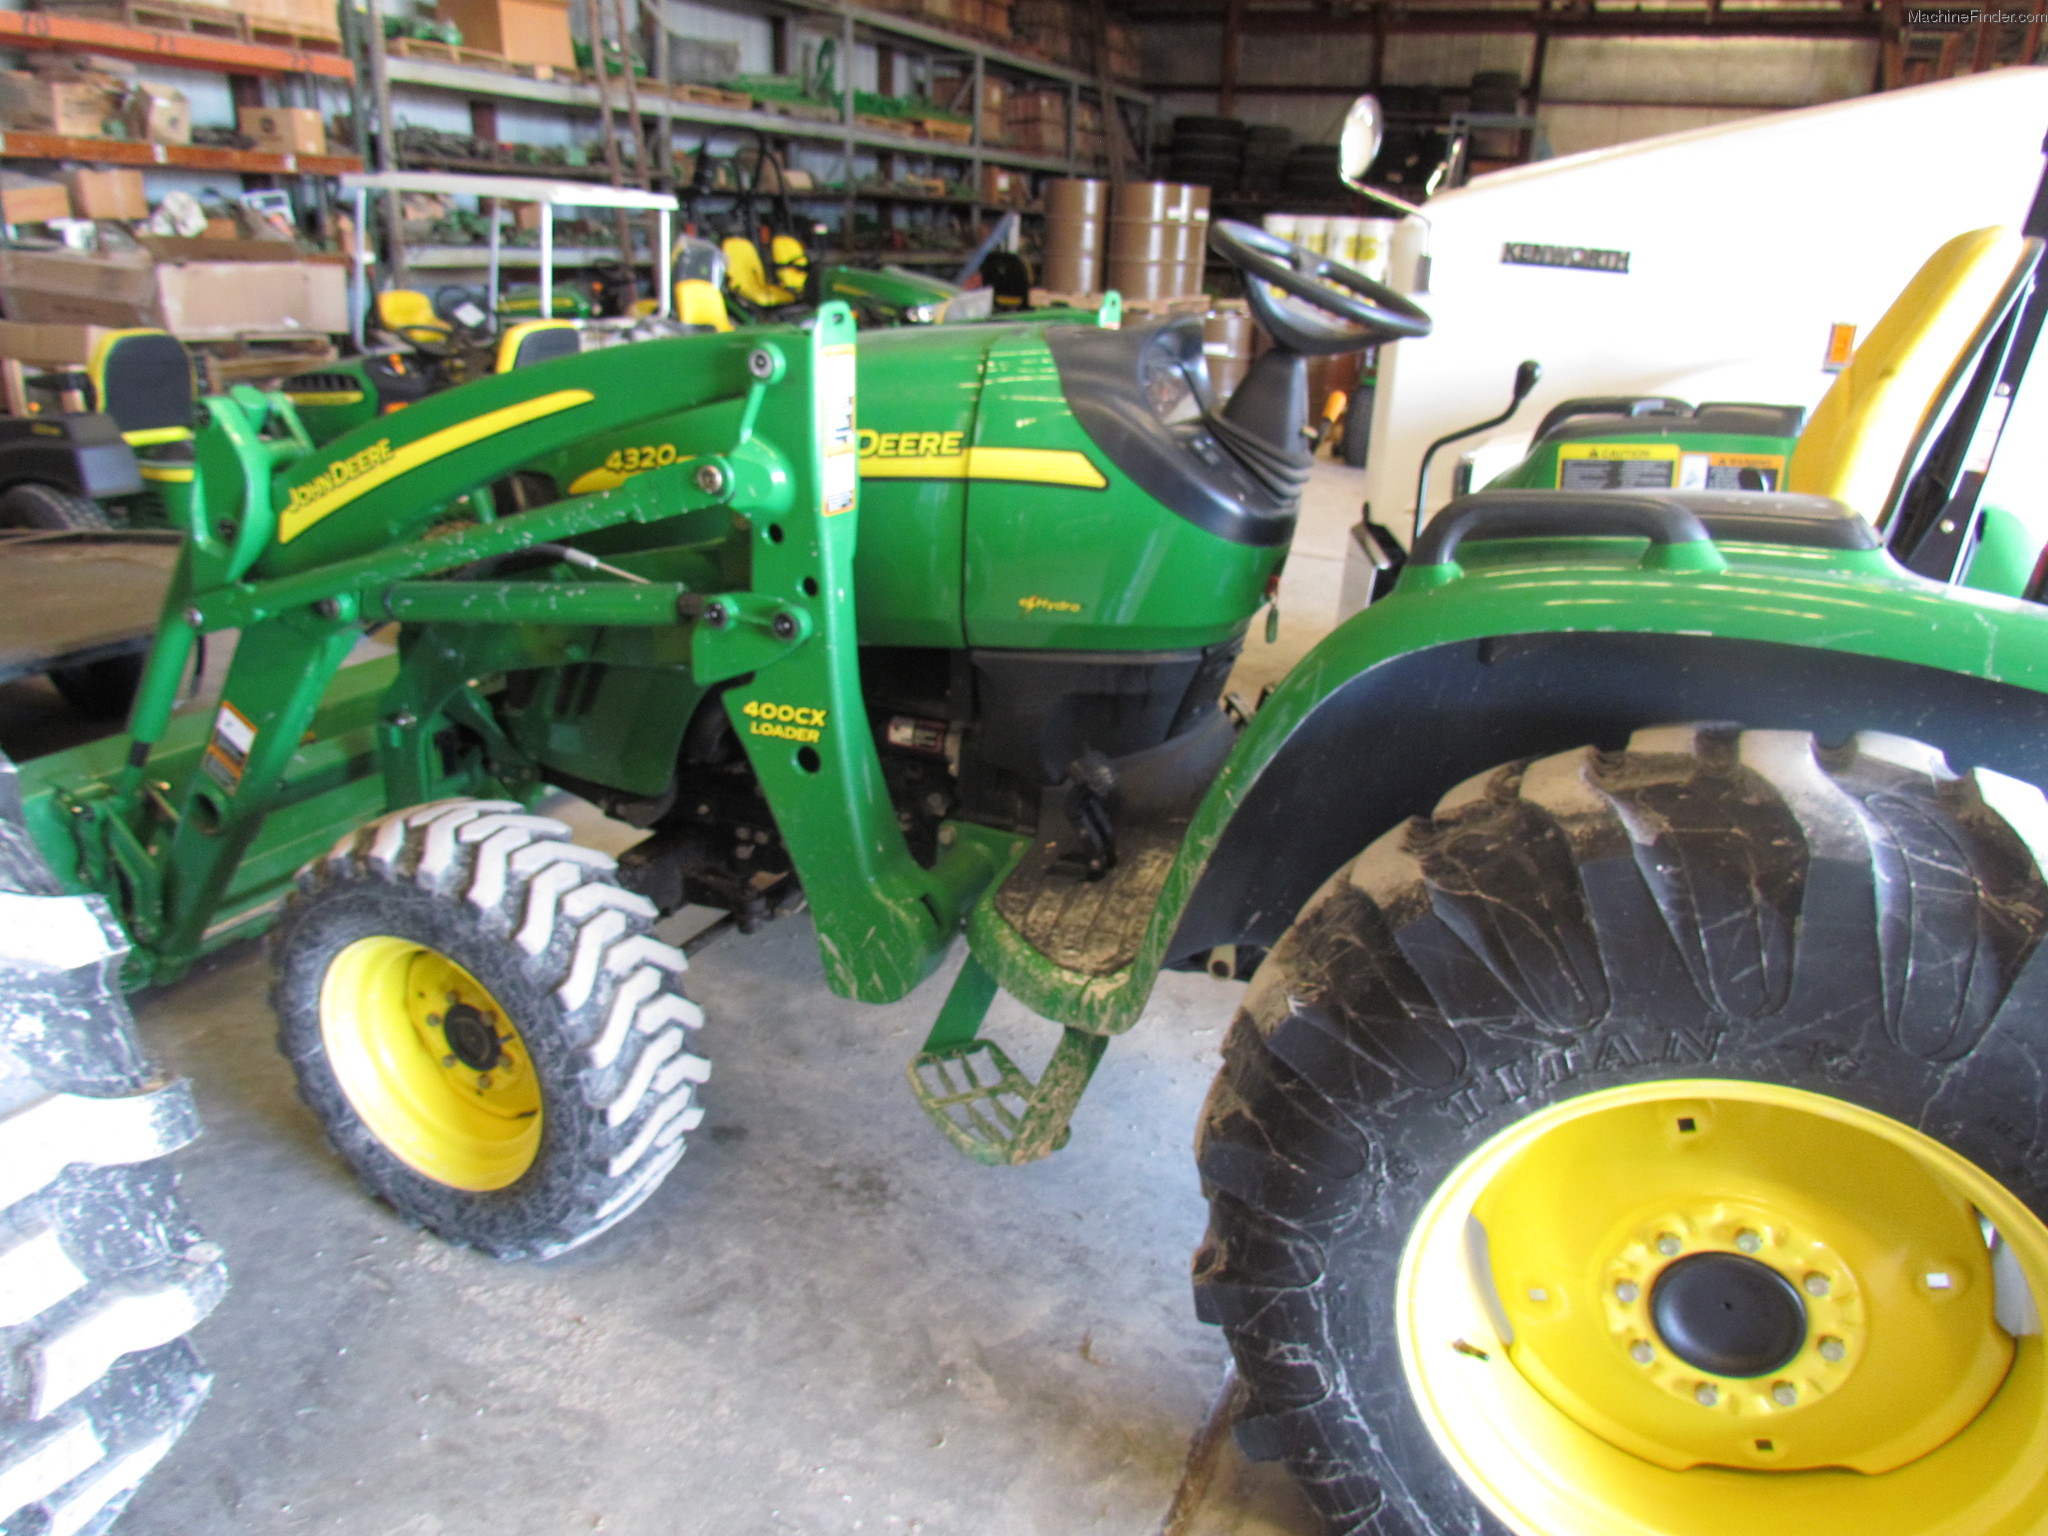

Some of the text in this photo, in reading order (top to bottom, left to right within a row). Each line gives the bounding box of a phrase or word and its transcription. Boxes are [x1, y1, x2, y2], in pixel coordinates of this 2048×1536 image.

[1501, 242, 1629, 273] KENWORTH
[605, 443, 677, 472] 4320
[857, 429, 964, 458] DEERE
[287, 438, 394, 513] JOHN DEERE
[742, 700, 828, 728] 400CX
[750, 720, 821, 744] LOADER
[1438, 1027, 1726, 1125] TITAN
